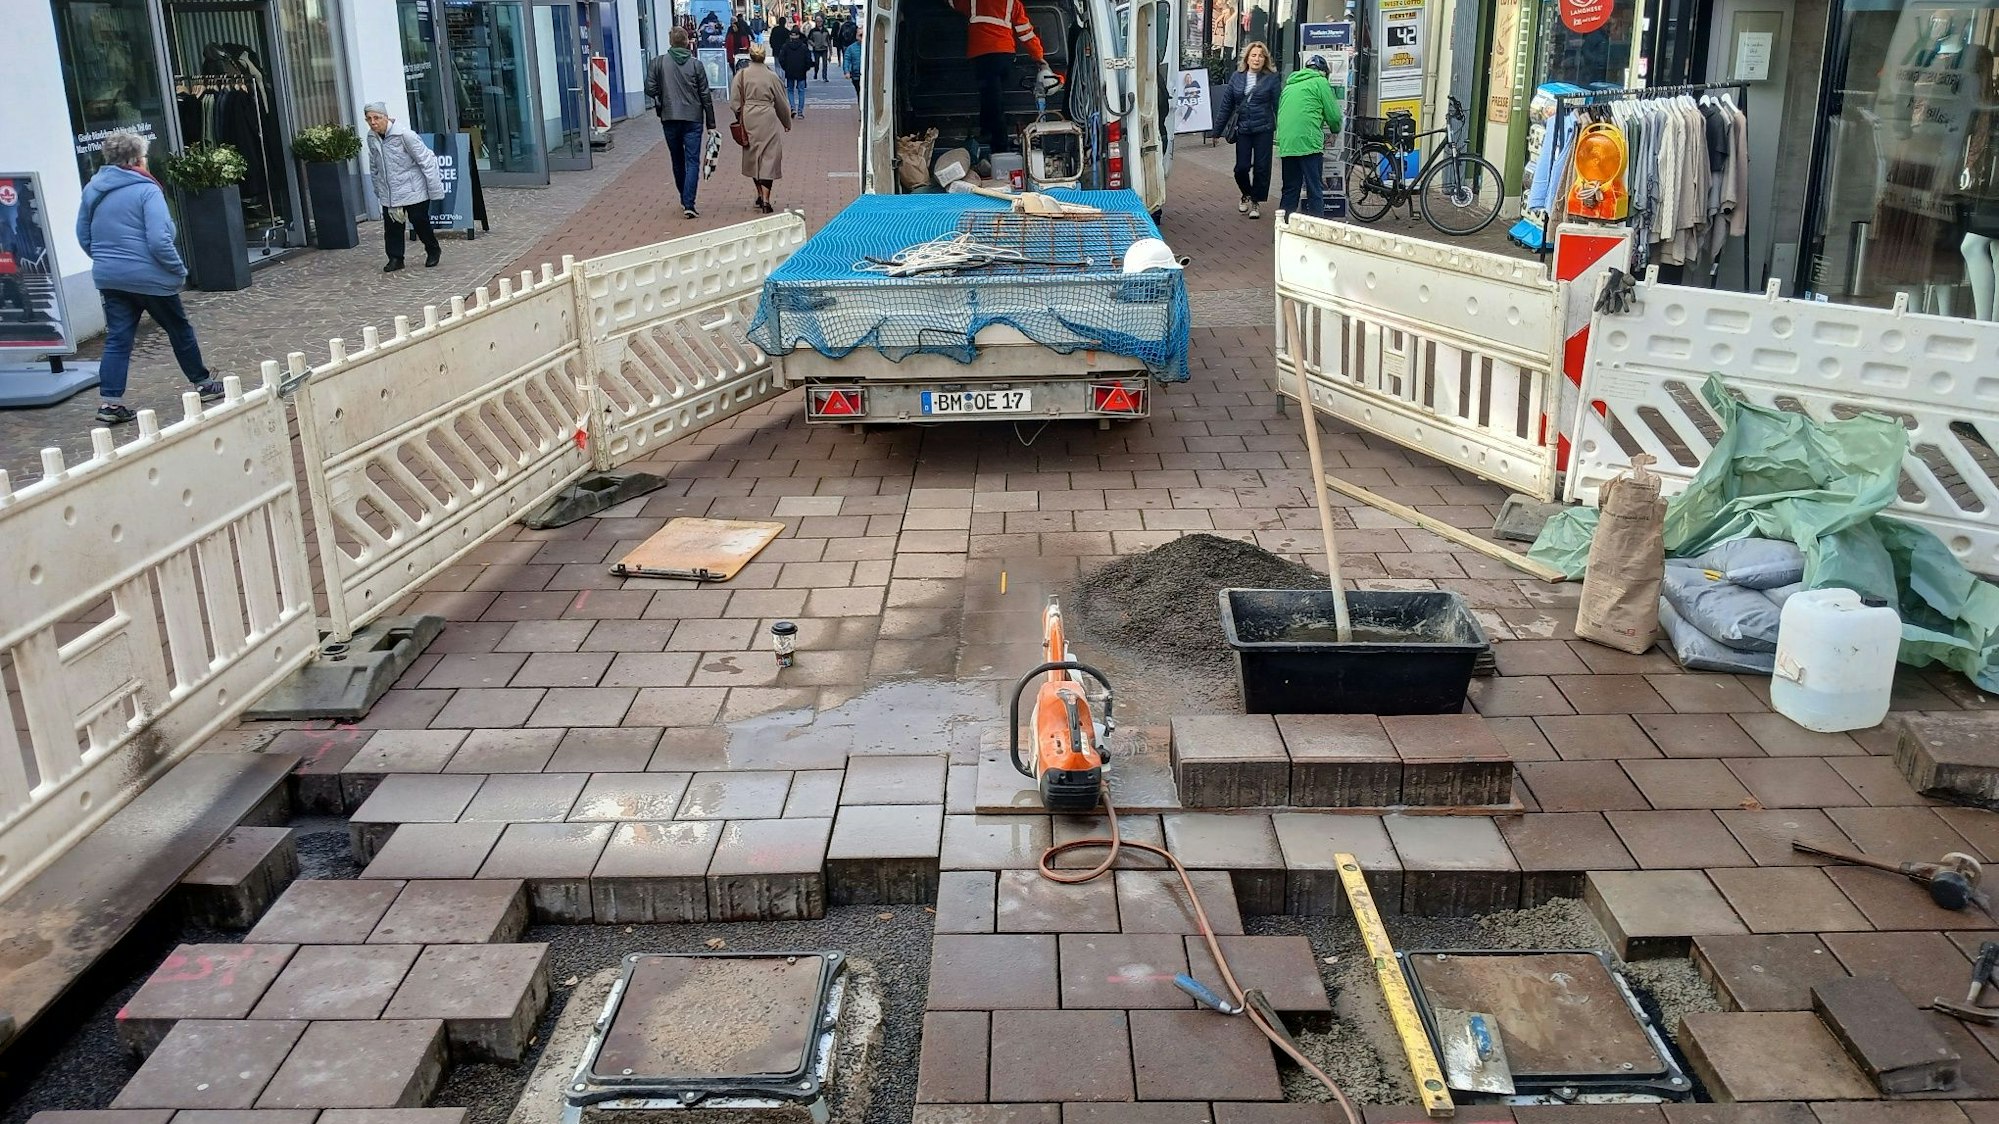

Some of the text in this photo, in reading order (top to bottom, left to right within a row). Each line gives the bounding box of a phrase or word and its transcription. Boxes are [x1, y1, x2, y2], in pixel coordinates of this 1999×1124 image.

[1570, 5, 1603, 16] LANGNESE
[1397, 26, 1416, 45] 42
[1492, 96, 1509, 108] PRESSE
[938, 394, 962, 411] BM
[974, 393, 998, 410] OE
[1002, 392, 1024, 409] 17
